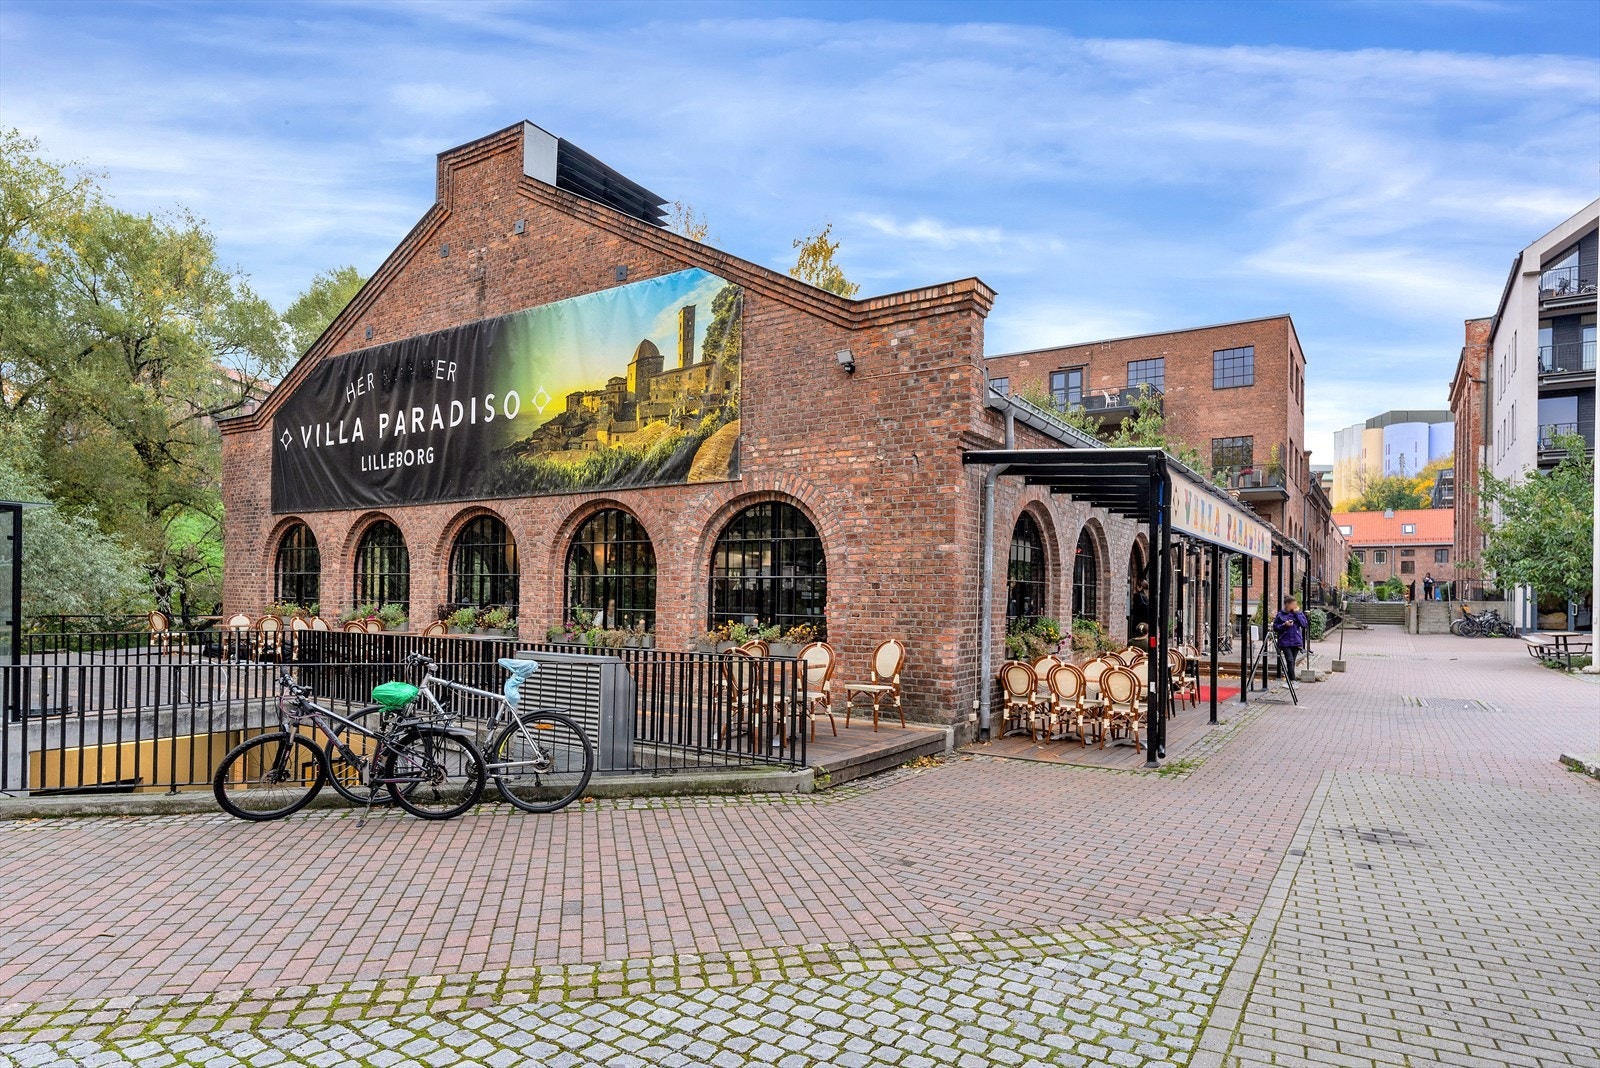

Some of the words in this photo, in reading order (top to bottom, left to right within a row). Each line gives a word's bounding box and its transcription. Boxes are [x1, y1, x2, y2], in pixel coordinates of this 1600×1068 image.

[346, 372, 375, 403] HER
[300, 417, 364, 449] VILLA
[379, 390, 521, 438] PARADISO
[361, 447, 434, 472] LILLEBORG
[1184, 488, 1220, 537] VILLA
